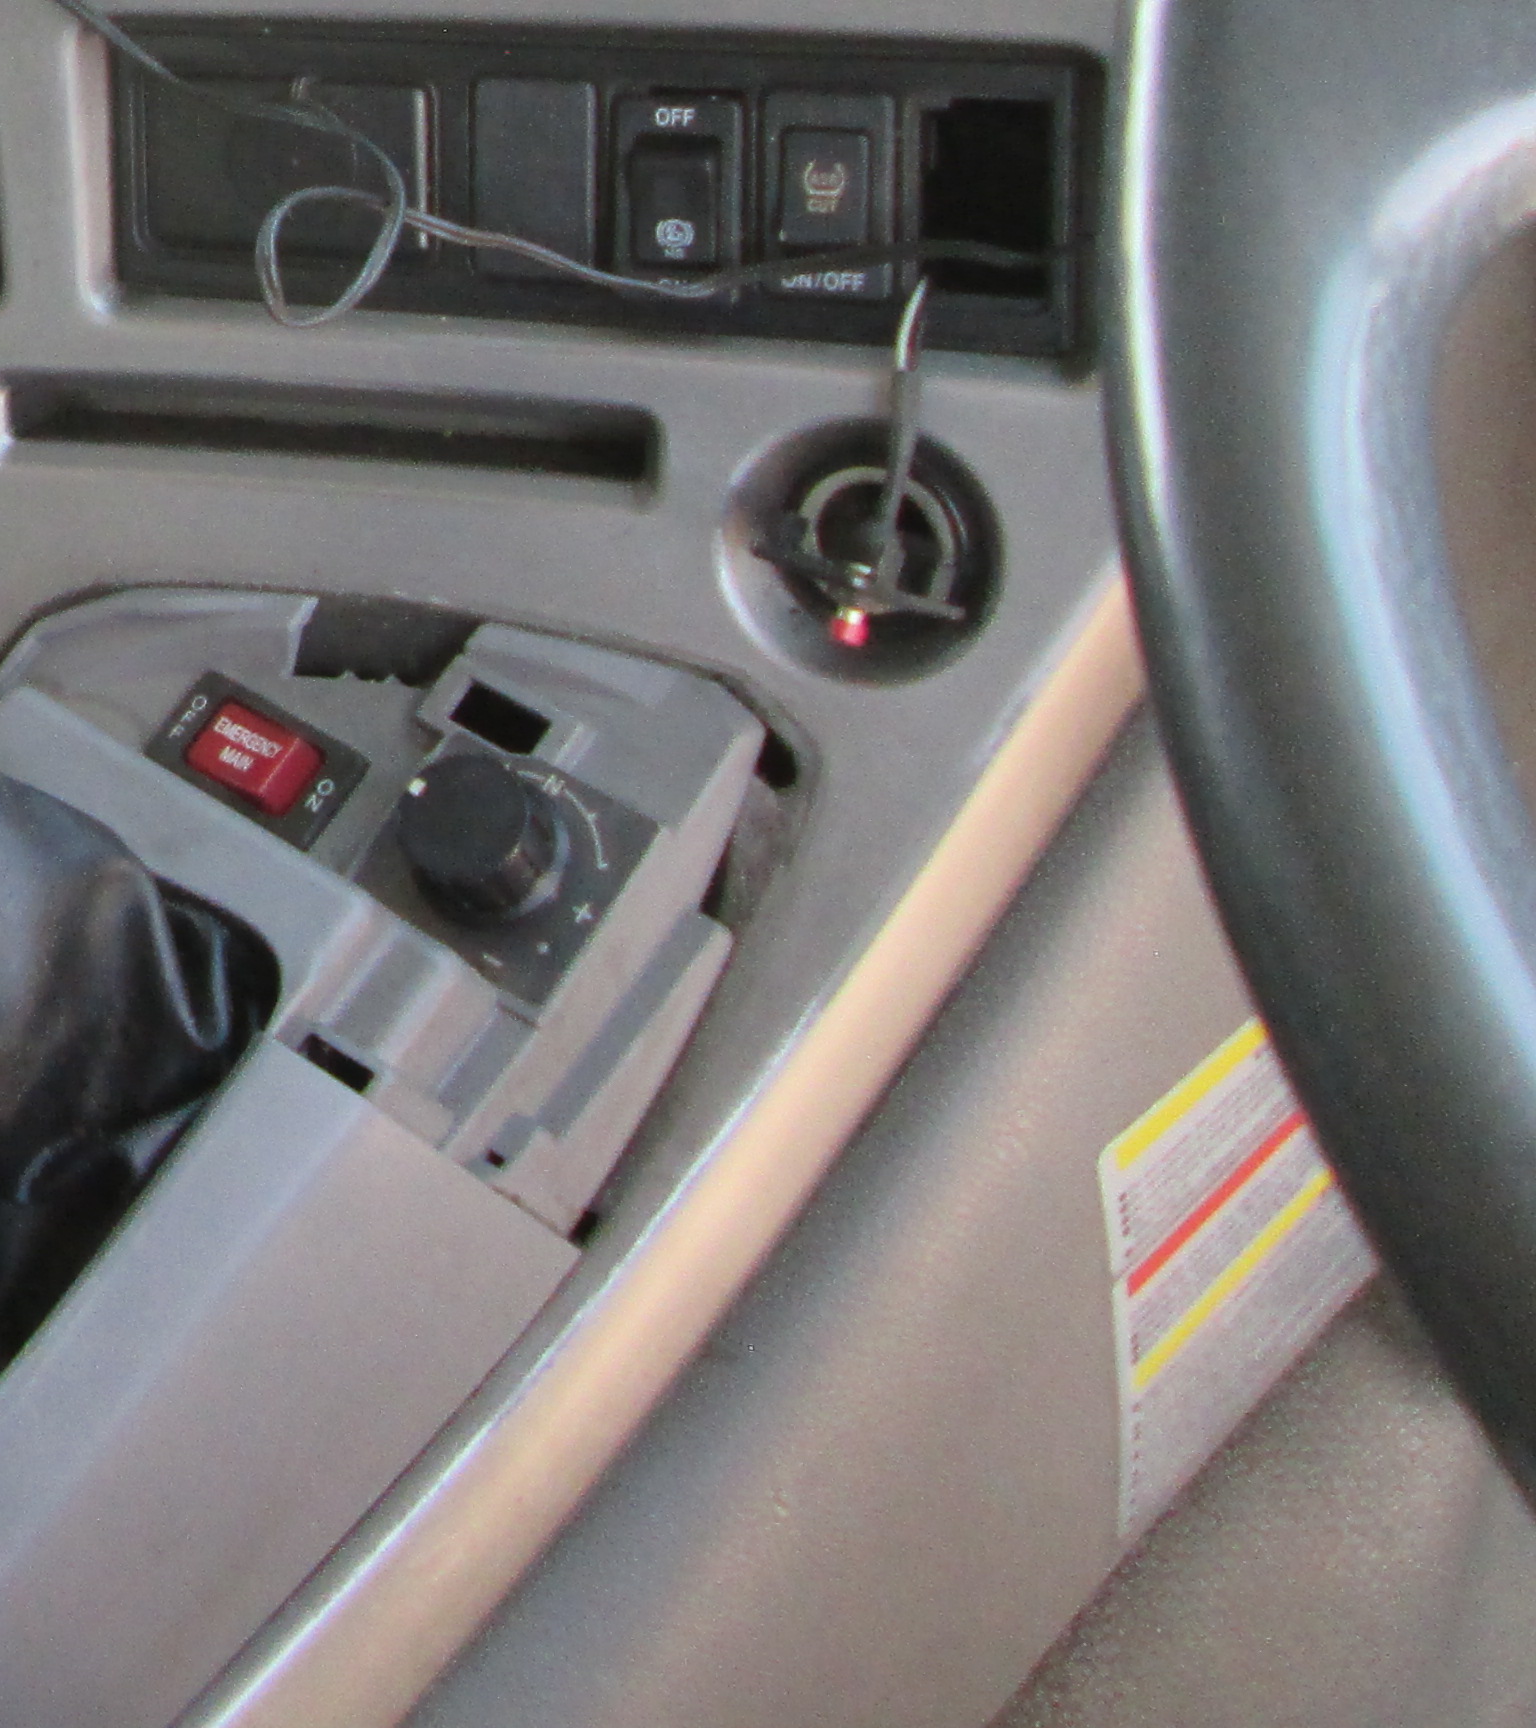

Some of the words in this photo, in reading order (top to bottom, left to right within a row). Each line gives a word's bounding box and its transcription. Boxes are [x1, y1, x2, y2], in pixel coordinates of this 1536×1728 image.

[655, 107, 696, 126] OFF
[780, 272, 866, 291] ON/OFF
[213, 715, 284, 759] EMERGENCY
[218, 745, 255, 772] MAIN
[303, 777, 335, 813] ON
